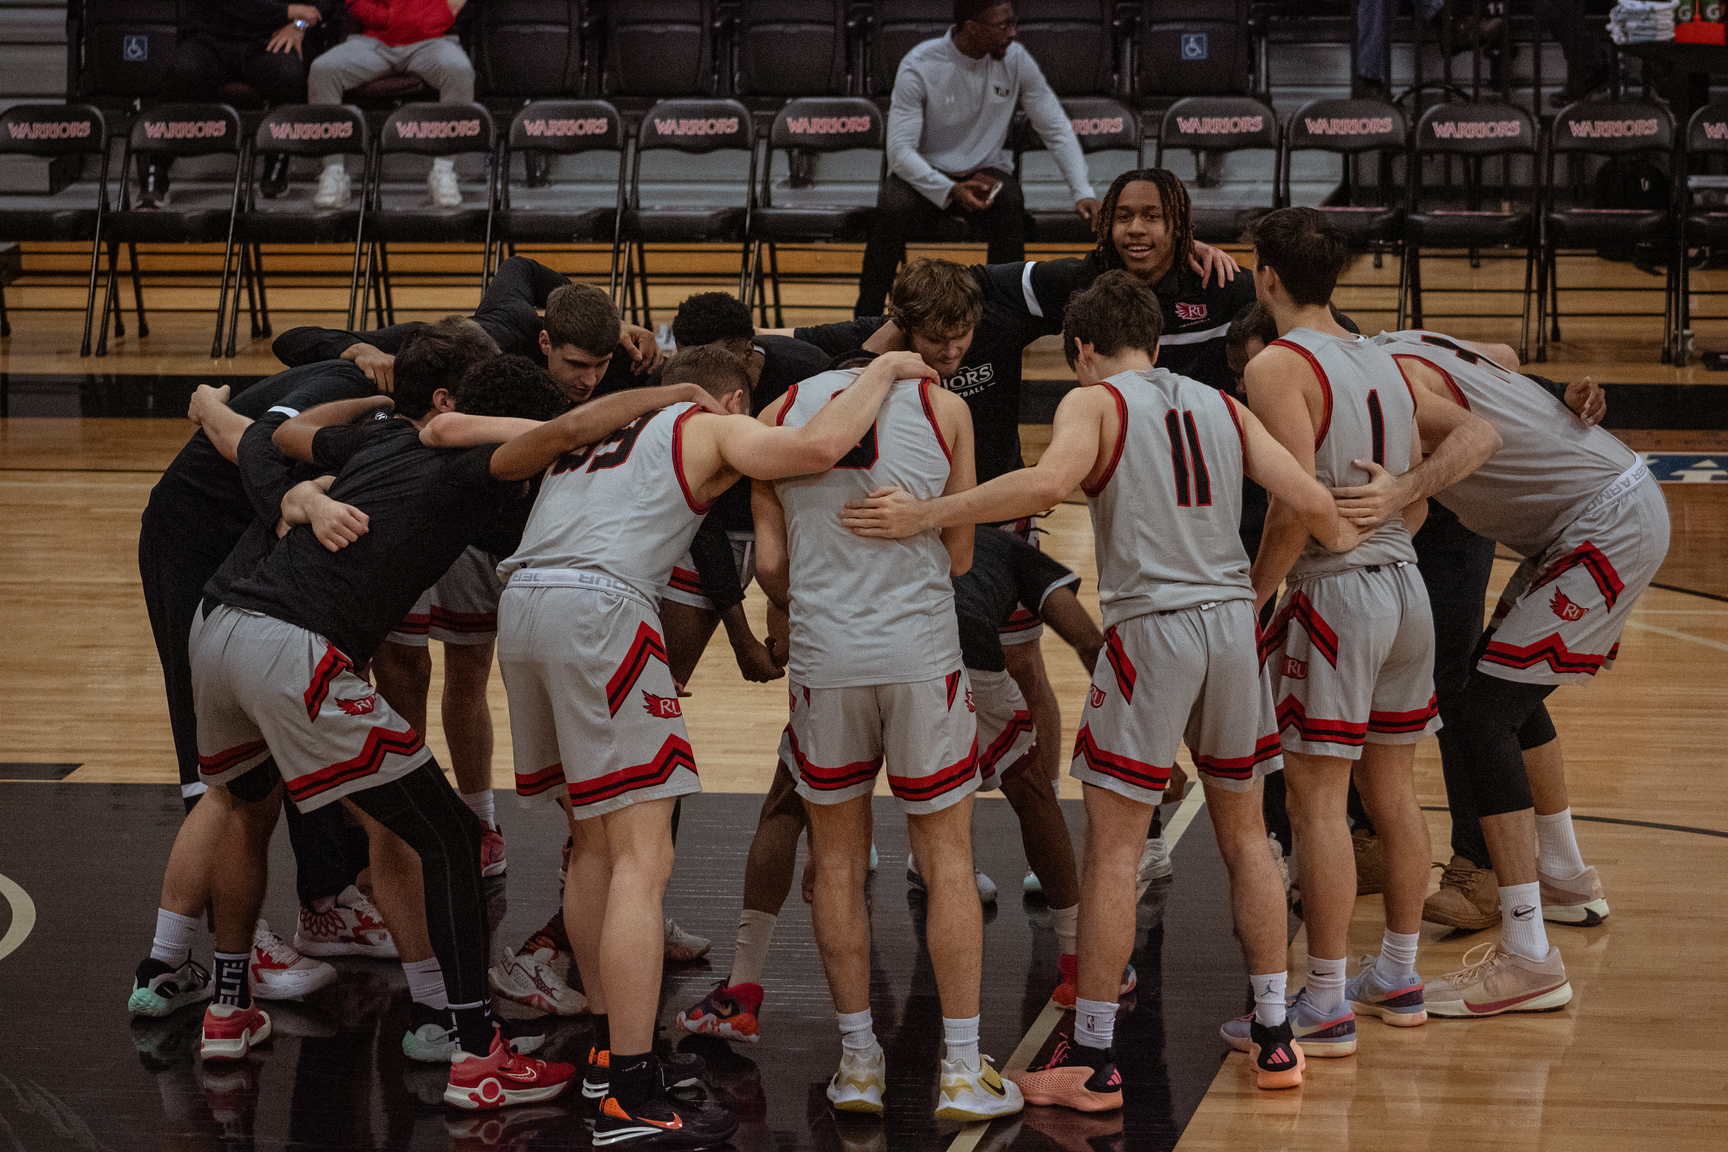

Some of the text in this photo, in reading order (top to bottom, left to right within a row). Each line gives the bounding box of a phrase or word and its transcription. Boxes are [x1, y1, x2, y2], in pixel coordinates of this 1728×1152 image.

[1706, 4, 1720, 20] G
[8, 121, 91, 139] WARRIORS
[144, 120, 226, 139] WARRIORS
[270, 121, 353, 140] WARRIORS
[396, 119, 480, 139] WARRIORS
[523, 117, 608, 136] WARRIORS
[654, 117, 739, 136] WARRIORS
[786, 116, 870, 134] WARRIORS
[1071, 117, 1123, 135] RIORS
[1176, 116, 1262, 134] WARRIORS
[1304, 117, 1392, 135] WARRIORS
[1432, 121, 1520, 138] WARRIORS
[1569, 118, 1658, 138] WARRIORS
[1188, 304, 1206, 317] RU
[941, 366, 991, 390] IORS
[1367, 389, 1384, 468] 1
[1165, 409, 1212, 507] 11
[1288, 660, 1307, 677] RU
